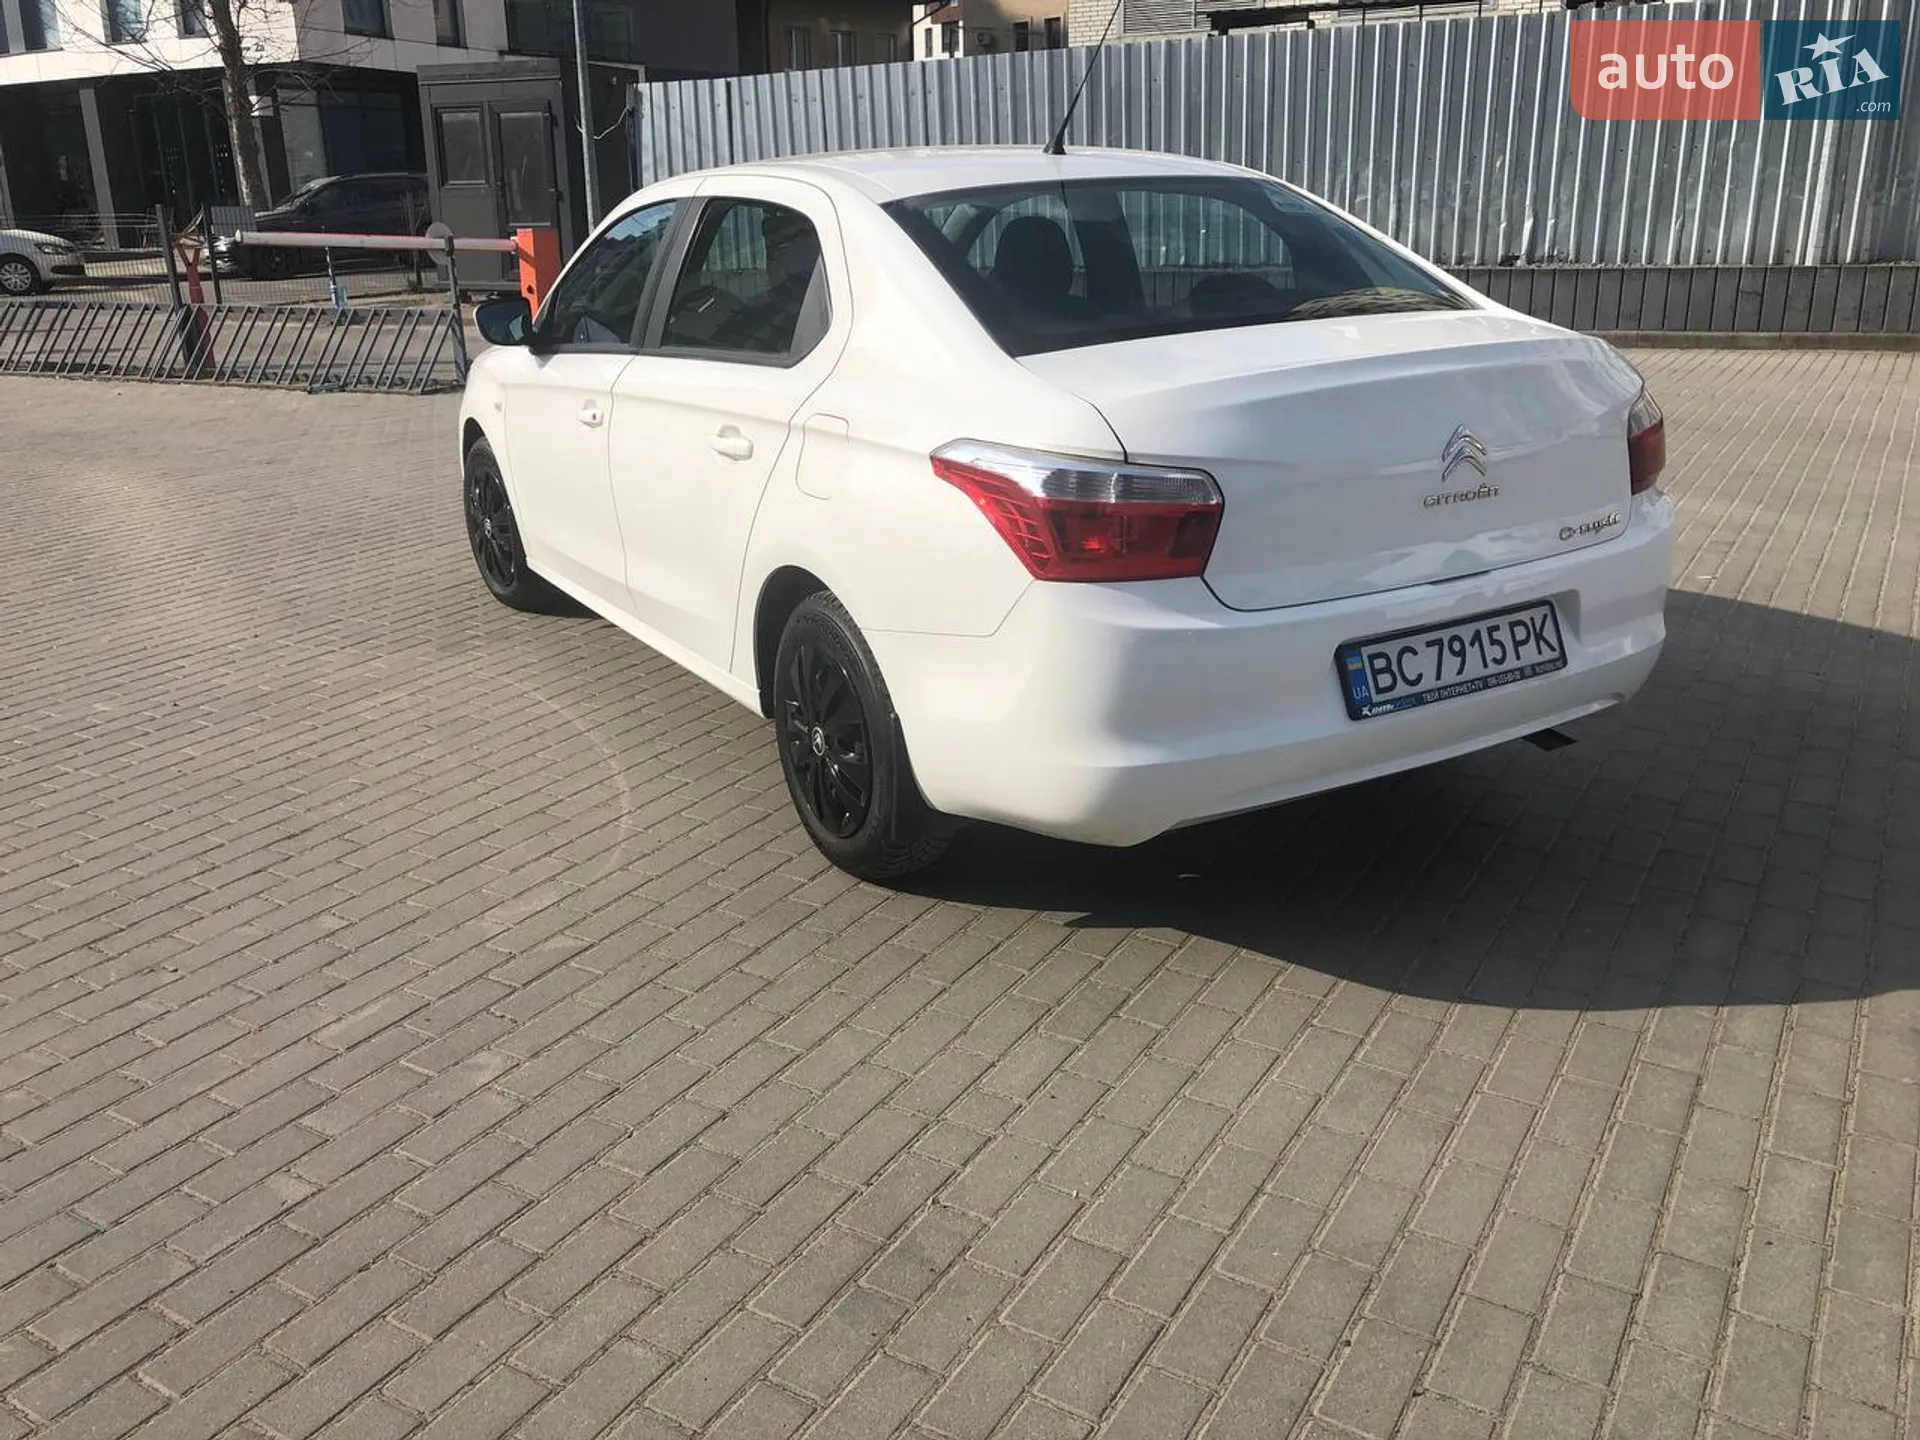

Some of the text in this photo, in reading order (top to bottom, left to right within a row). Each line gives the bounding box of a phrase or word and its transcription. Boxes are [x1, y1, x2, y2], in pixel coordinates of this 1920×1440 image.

[1367, 646, 1424, 695] BC
[1425, 624, 1508, 682] 7915
[1507, 612, 1557, 661] PK
[1353, 685, 1369, 700] UA
